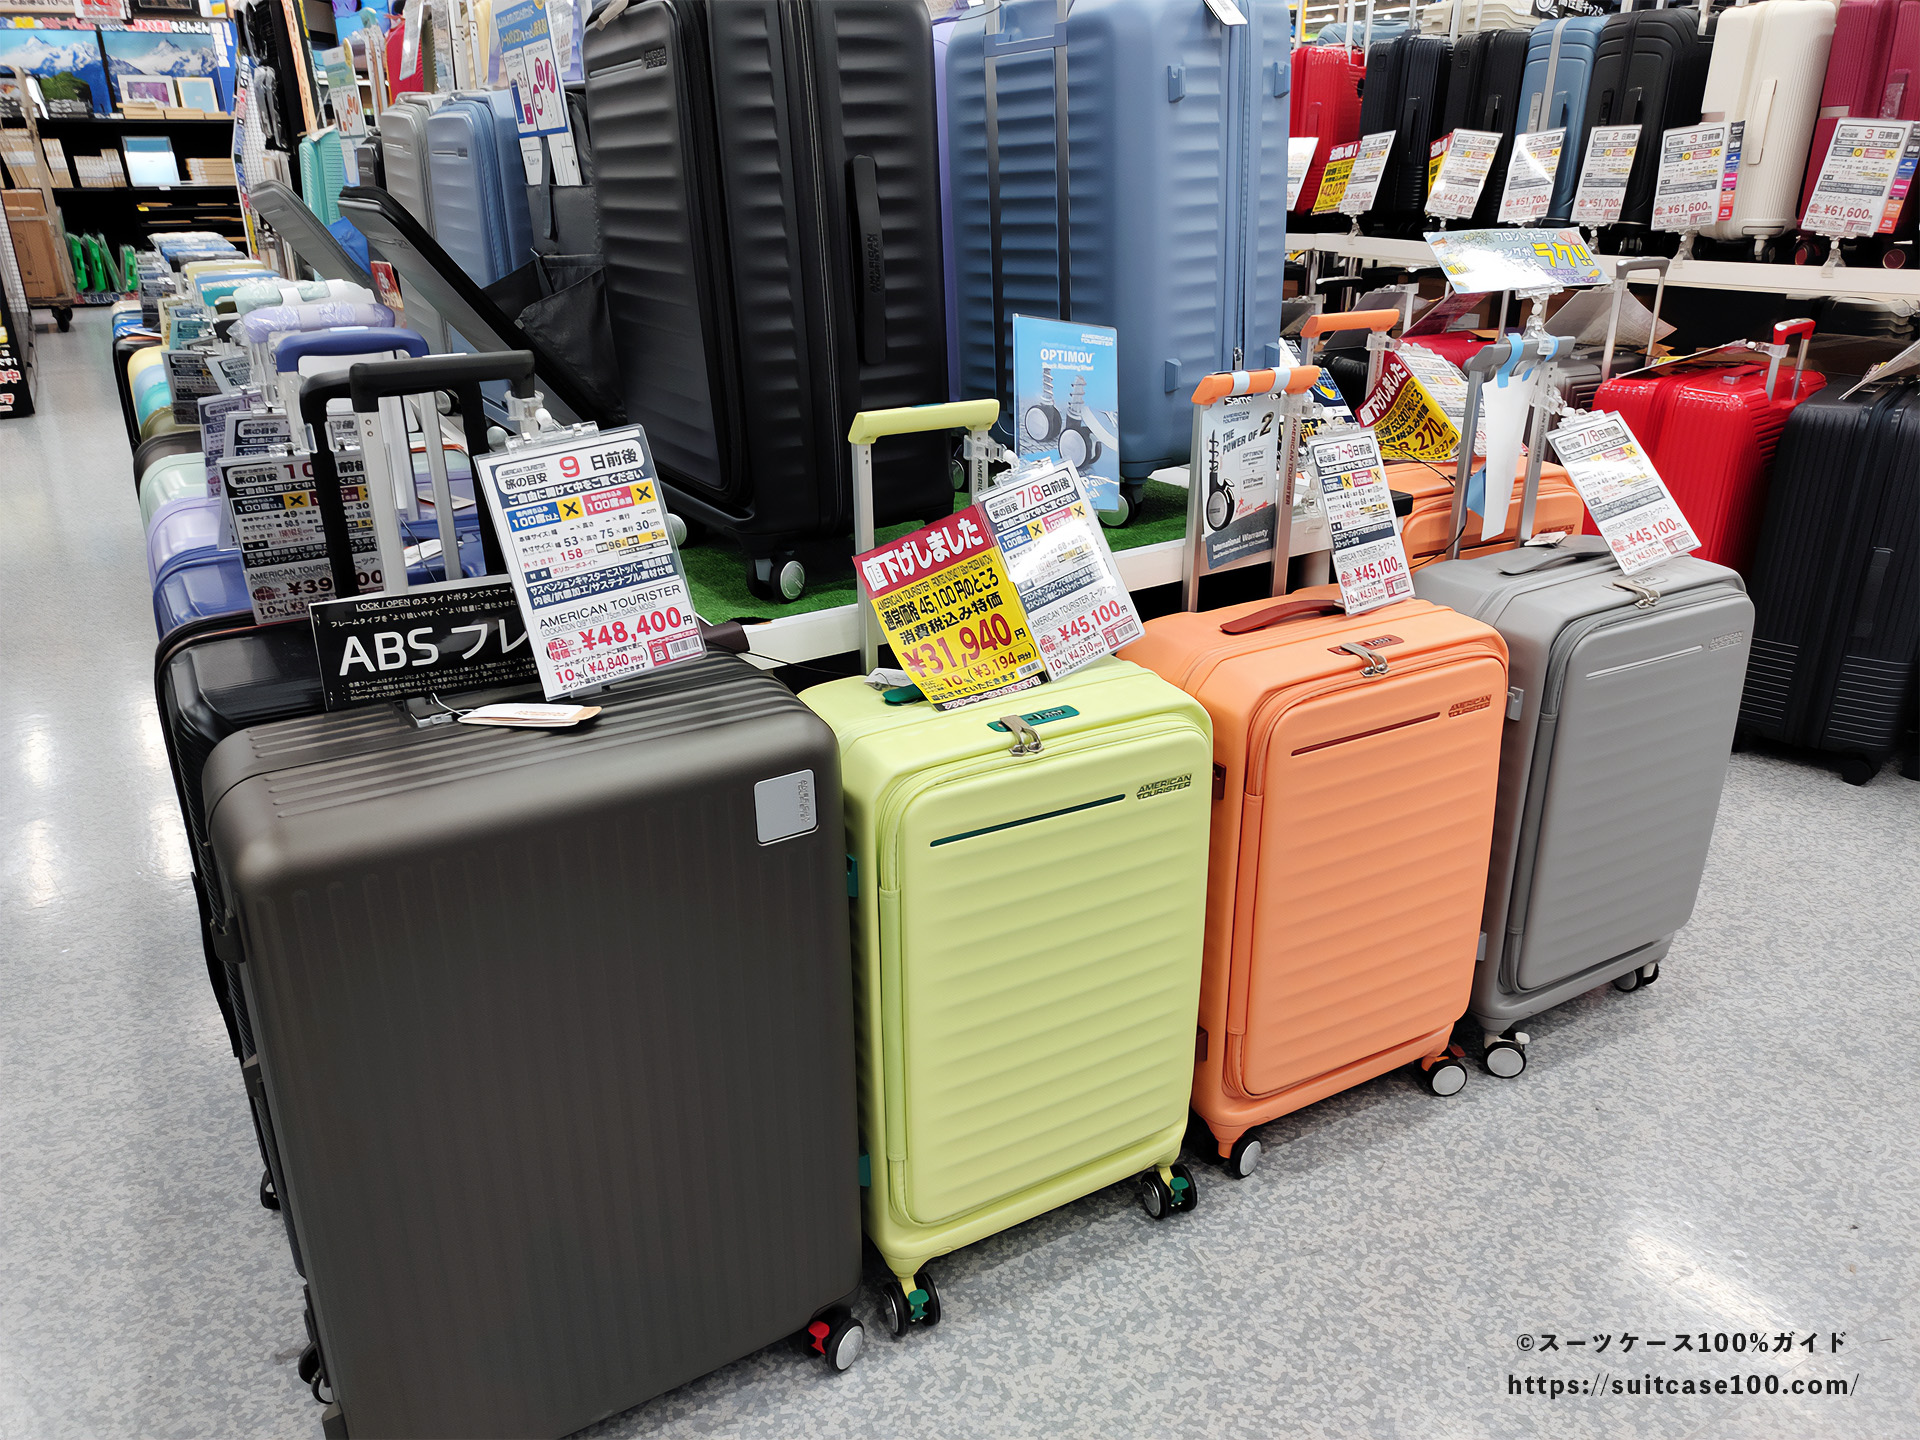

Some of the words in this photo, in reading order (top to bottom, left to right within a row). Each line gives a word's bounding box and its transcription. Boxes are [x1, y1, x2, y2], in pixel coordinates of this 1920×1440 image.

[1690, 134, 1698, 143] 3
[1865, 129, 1874, 139] 3
[1516, 194, 1547, 206] ¥51,700
[1668, 201, 1708, 214] ¥61,600
[1824, 204, 1870, 220] ¥61,600
[1531, 242, 1594, 268] ラク!!
[1040, 348, 1093, 364] OPTIMOV
[1222, 411, 1250, 420] AMERICAN
[1222, 415, 1250, 424] TOURISTER
[1222, 437, 1247, 455] POWER
[1248, 429, 1258, 443] OF
[1259, 411, 1275, 437] 2
[1222, 429, 1235, 443] THE
[1289, 418, 1297, 462] AMERICAN
[1578, 429, 1600, 447] 7/8
[235, 473, 278, 485] 旅の目安
[505, 472, 548, 490] 旅の目安
[559, 455, 581, 478] 9
[590, 447, 639, 471] 日前後
[1285, 463, 1295, 505] TOURISTER
[992, 502, 1019, 519] 旅の目安
[1016, 484, 1044, 508] 7/8
[1042, 477, 1071, 497] 日前後
[283, 511, 297, 519] 49
[564, 536, 579, 547] 53
[599, 528, 614, 539] 75
[635, 520, 650, 531] 30
[1213, 535, 1241, 552] International
[1242, 529, 1268, 543] Warranty
[1625, 517, 1677, 546] ¥45,100
[560, 548, 584, 562] 158
[861, 517, 984, 592] 値下げしました
[250, 567, 296, 581] AMERICAN
[1354, 555, 1398, 584] ¥45,100
[355, 602, 381, 612] LOCK
[386, 599, 411, 609] OPEN
[539, 603, 608, 630] AMERICAN
[610, 584, 681, 611] TOURISTER
[882, 601, 921, 632] 通常価格
[919, 586, 955, 615] 45,100
[955, 567, 999, 602] 円のところ
[578, 606, 682, 651] ¥48,400
[683, 614, 693, 626] 円
[899, 591, 1003, 646] 消費税込み特価
[1058, 600, 1121, 641] ¥45,100
[1121, 604, 1128, 613] 円
[339, 626, 439, 676] ABS
[451, 618, 528, 660] フレ
[901, 613, 1012, 678] ¥31,940
[1014, 627, 1027, 641] 円
[1449, 694, 1492, 712] AMERICAN
[1137, 781, 1191, 800] TOURISTER
[1138, 773, 1192, 793] AMERICAN
